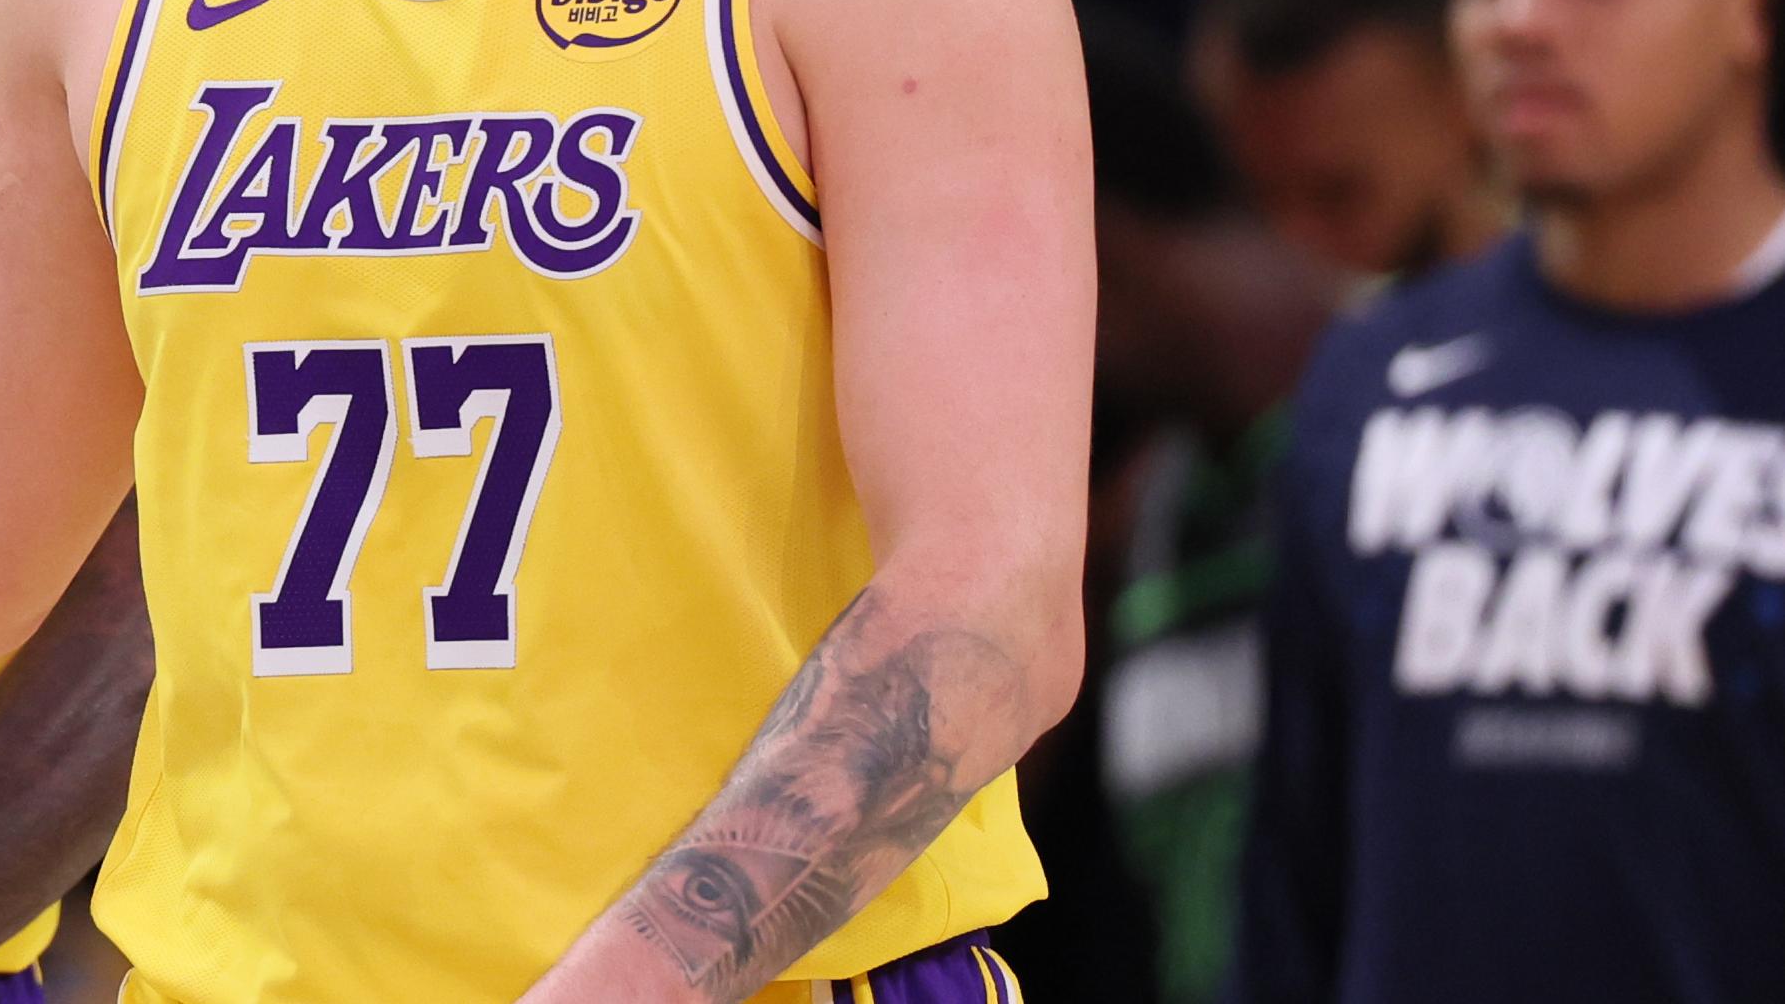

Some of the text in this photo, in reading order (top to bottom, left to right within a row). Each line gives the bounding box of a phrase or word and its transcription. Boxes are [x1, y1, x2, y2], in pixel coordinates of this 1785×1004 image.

[568, 6, 618, 24] 비비고
[136, 79, 644, 296] LAKERS
[243, 331, 562, 678] 77
[1347, 407, 1785, 578] WOLVE
[1393, 546, 1737, 706] BACK
